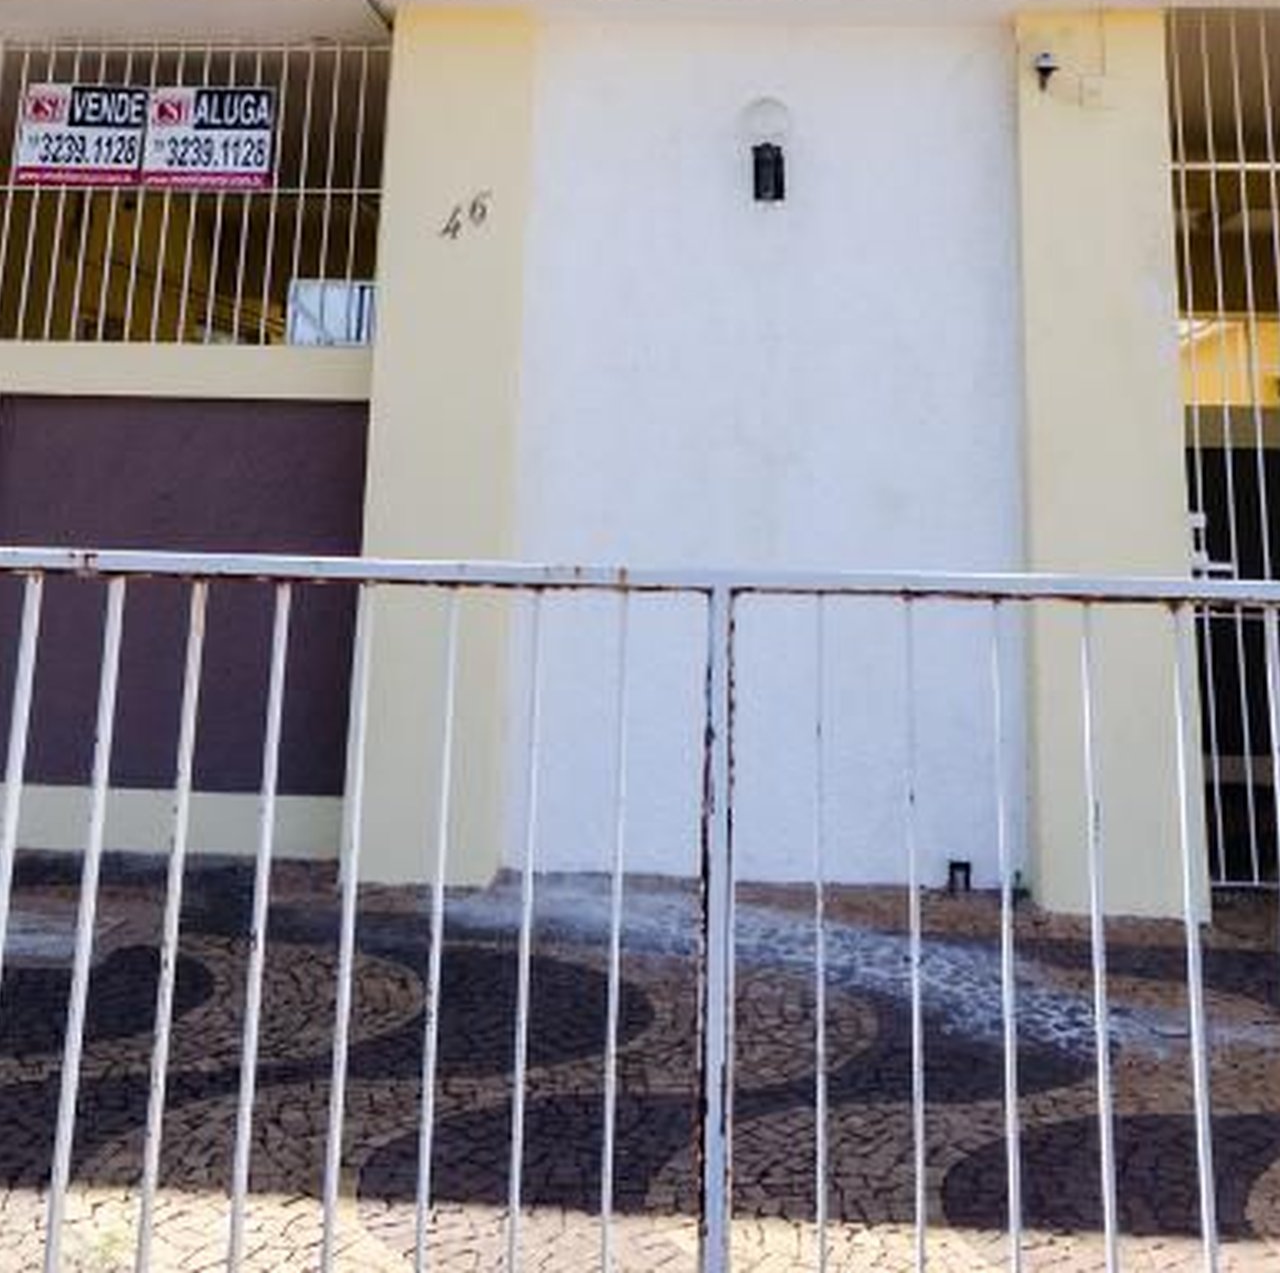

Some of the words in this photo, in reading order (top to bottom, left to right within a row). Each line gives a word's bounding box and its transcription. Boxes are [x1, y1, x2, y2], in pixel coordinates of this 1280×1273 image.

[74, 89, 146, 124] VENDE
[196, 93, 270, 125] ALUGA
[39, 133, 136, 164] 3239.1128
[167, 136, 266, 167] 3239.1128
[436, 189, 493, 240] 46
